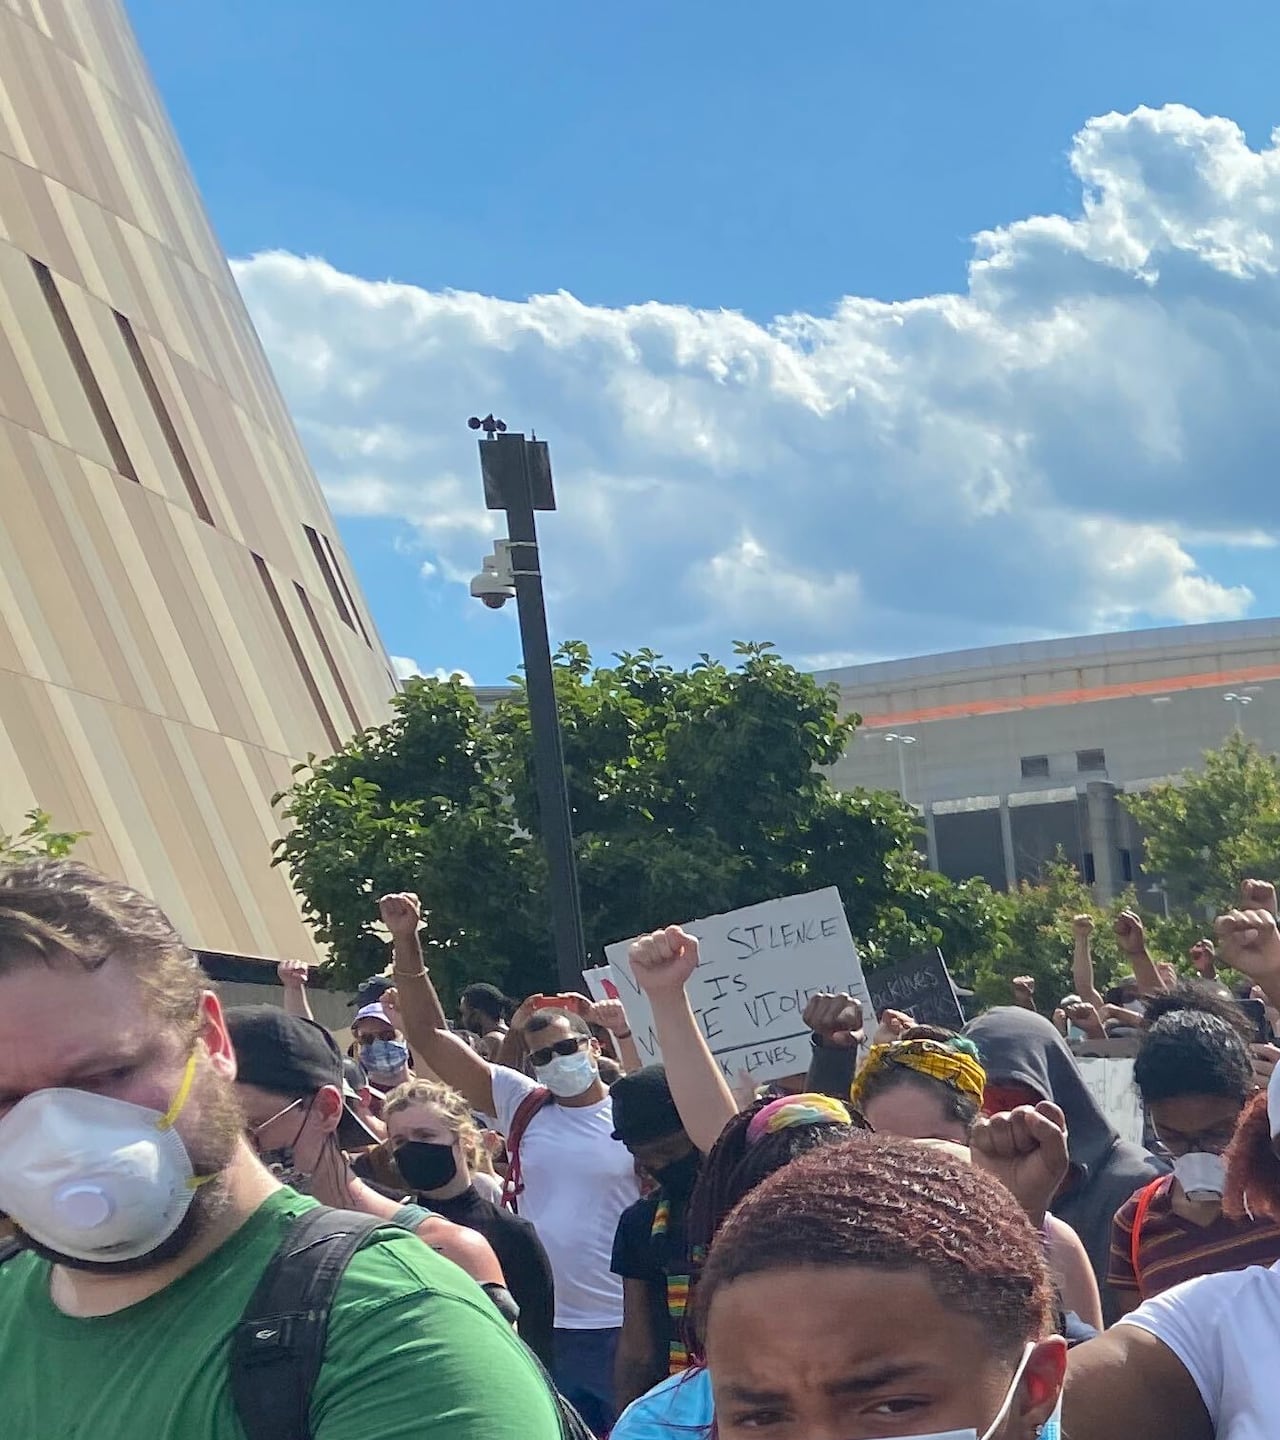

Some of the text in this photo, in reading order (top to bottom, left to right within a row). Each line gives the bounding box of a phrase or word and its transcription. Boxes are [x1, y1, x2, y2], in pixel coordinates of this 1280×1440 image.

[727, 916, 840, 960] SILENCE
[704, 974, 748, 1001] IS
[745, 1046, 797, 1074] LIVES
